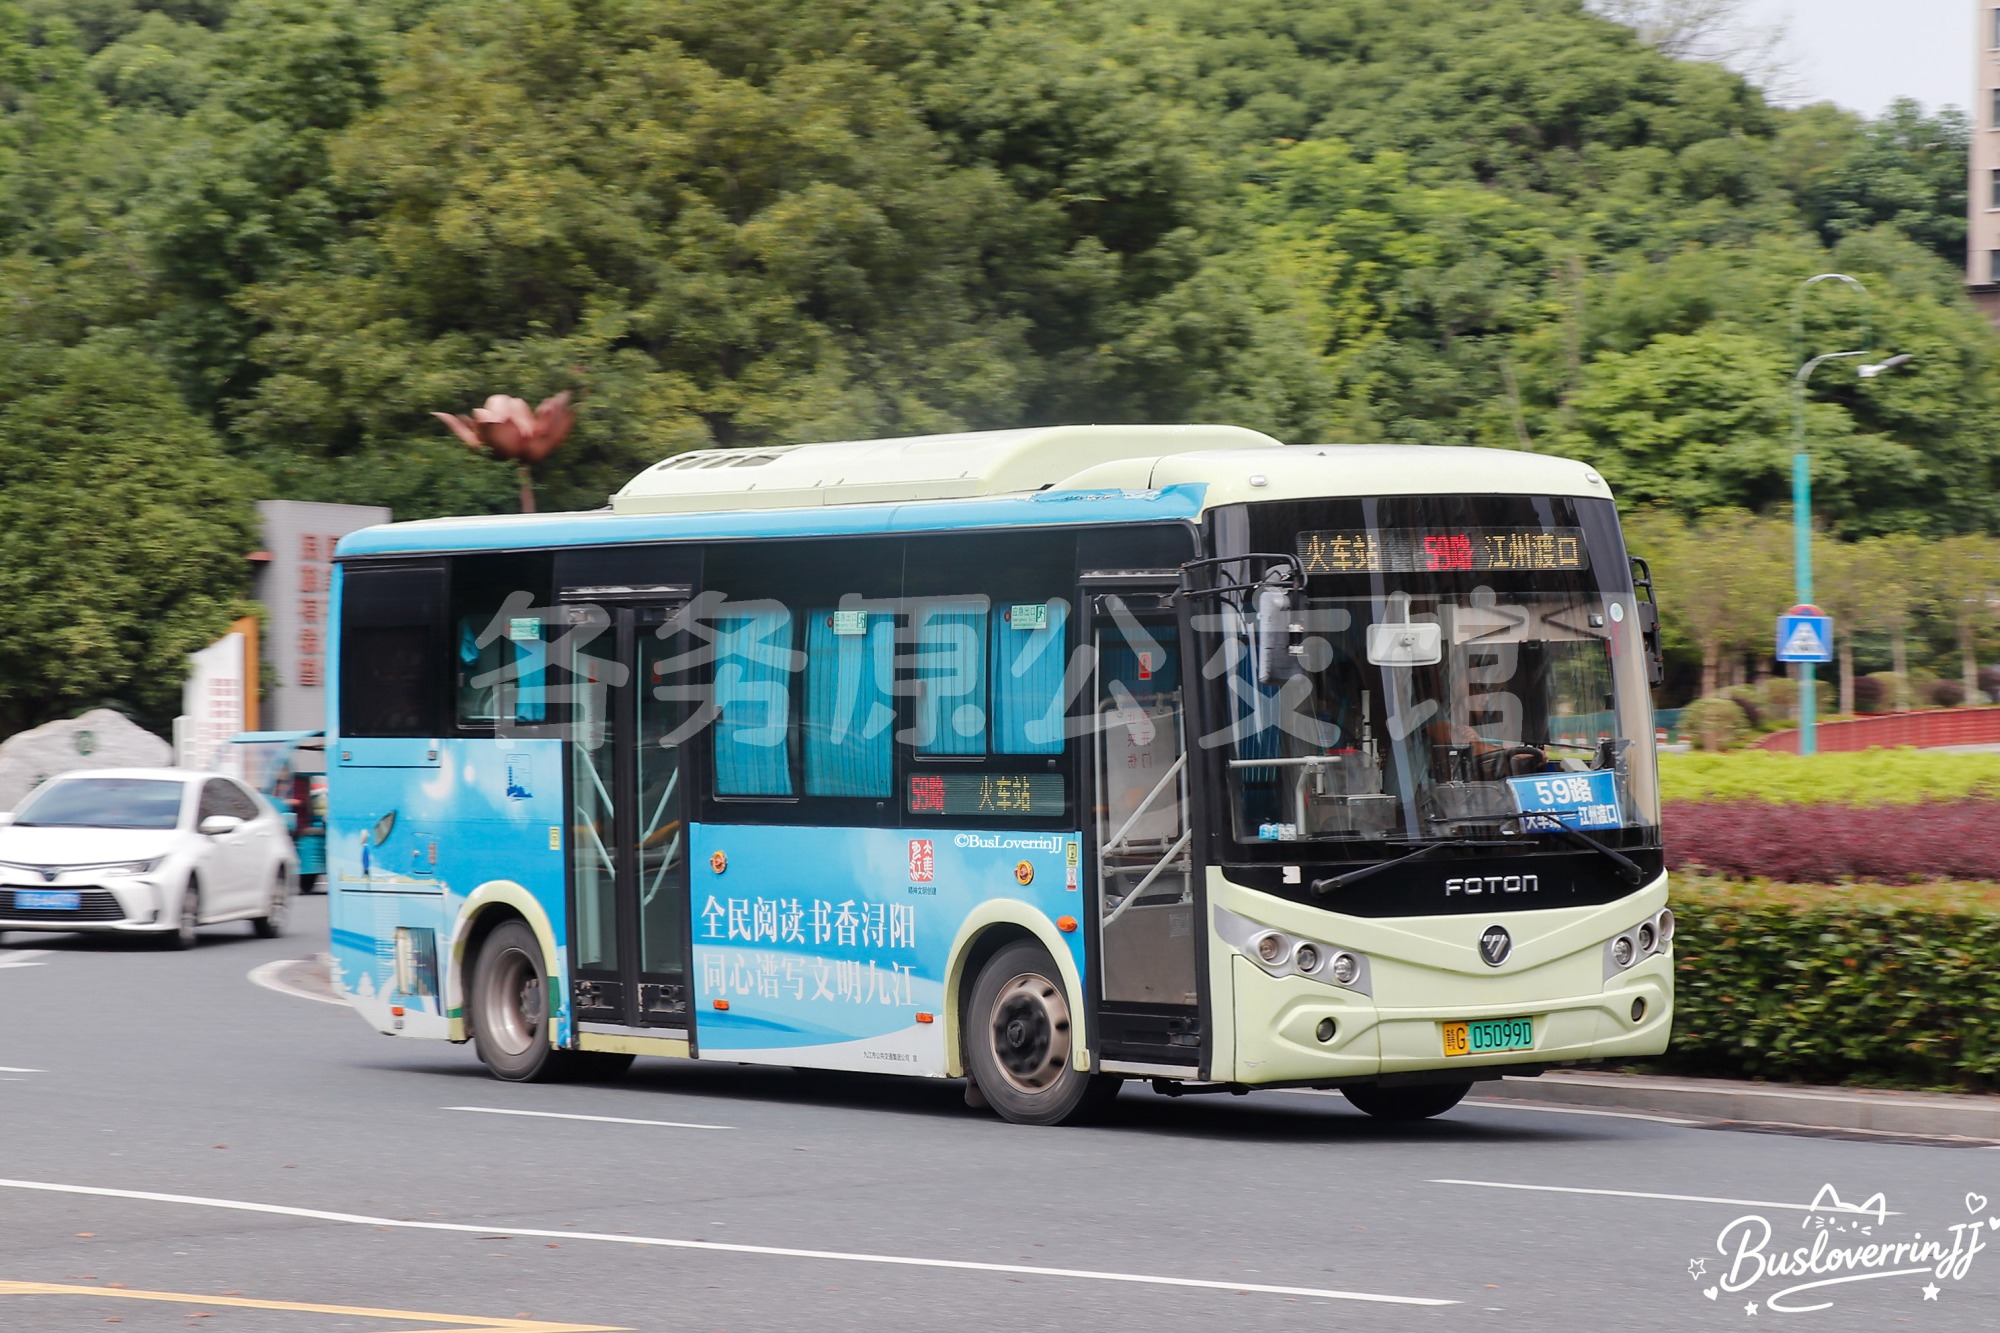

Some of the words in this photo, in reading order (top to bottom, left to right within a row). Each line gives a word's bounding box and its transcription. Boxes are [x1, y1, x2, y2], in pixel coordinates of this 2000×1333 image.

[1306, 535, 1380, 571] 火车站
[1424, 534, 1473, 569] 59路
[1485, 534, 1579, 568] 江州渡口
[911, 775, 944, 810] 59路
[978, 775, 1030, 811] 火车站
[1535, 778, 1593, 805] 59路
[1446, 875, 1538, 896] FOTON
[701, 895, 915, 948] 全民阅读书香浔阳
[703, 952, 919, 1007] 同心谱写文明九江
